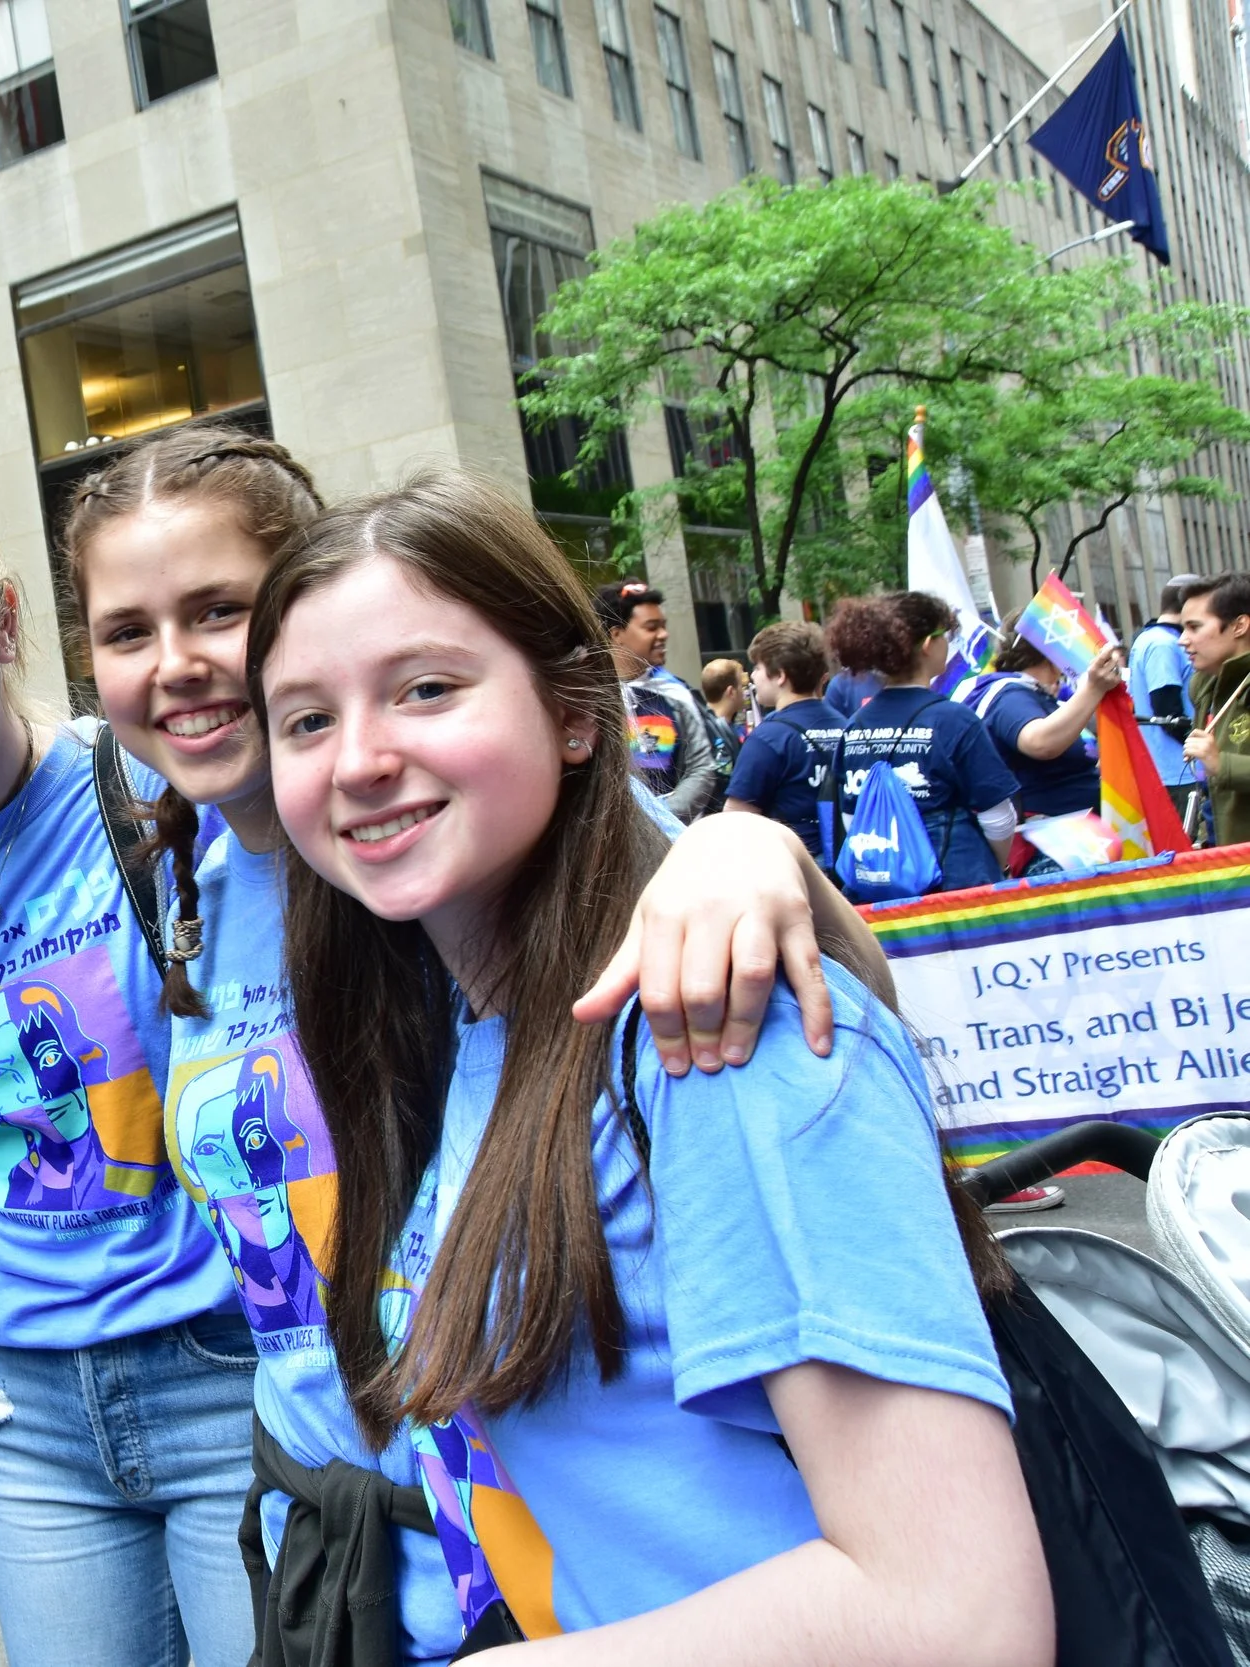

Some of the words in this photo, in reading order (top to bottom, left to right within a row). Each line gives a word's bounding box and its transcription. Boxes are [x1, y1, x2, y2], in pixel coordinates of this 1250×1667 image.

[871, 728, 894, 739] AND
[21, 912, 121, 969] ממקומות
[971, 954, 1052, 999] J.Q.Y
[1063, 939, 1206, 978] Presents
[243, 984, 267, 1012] מול
[226, 1021, 248, 1047] כך
[244, 1022, 269, 1048] כל
[966, 1020, 1074, 1051] Trans,
[1087, 1001, 1158, 1039] and
[1171, 996, 1209, 1028] Bi
[935, 1071, 1002, 1106] and
[1013, 1055, 1160, 1099] Straight
[52, 1213, 94, 1230] PLACES,
[94, 1200, 149, 1221] TOGETHER
